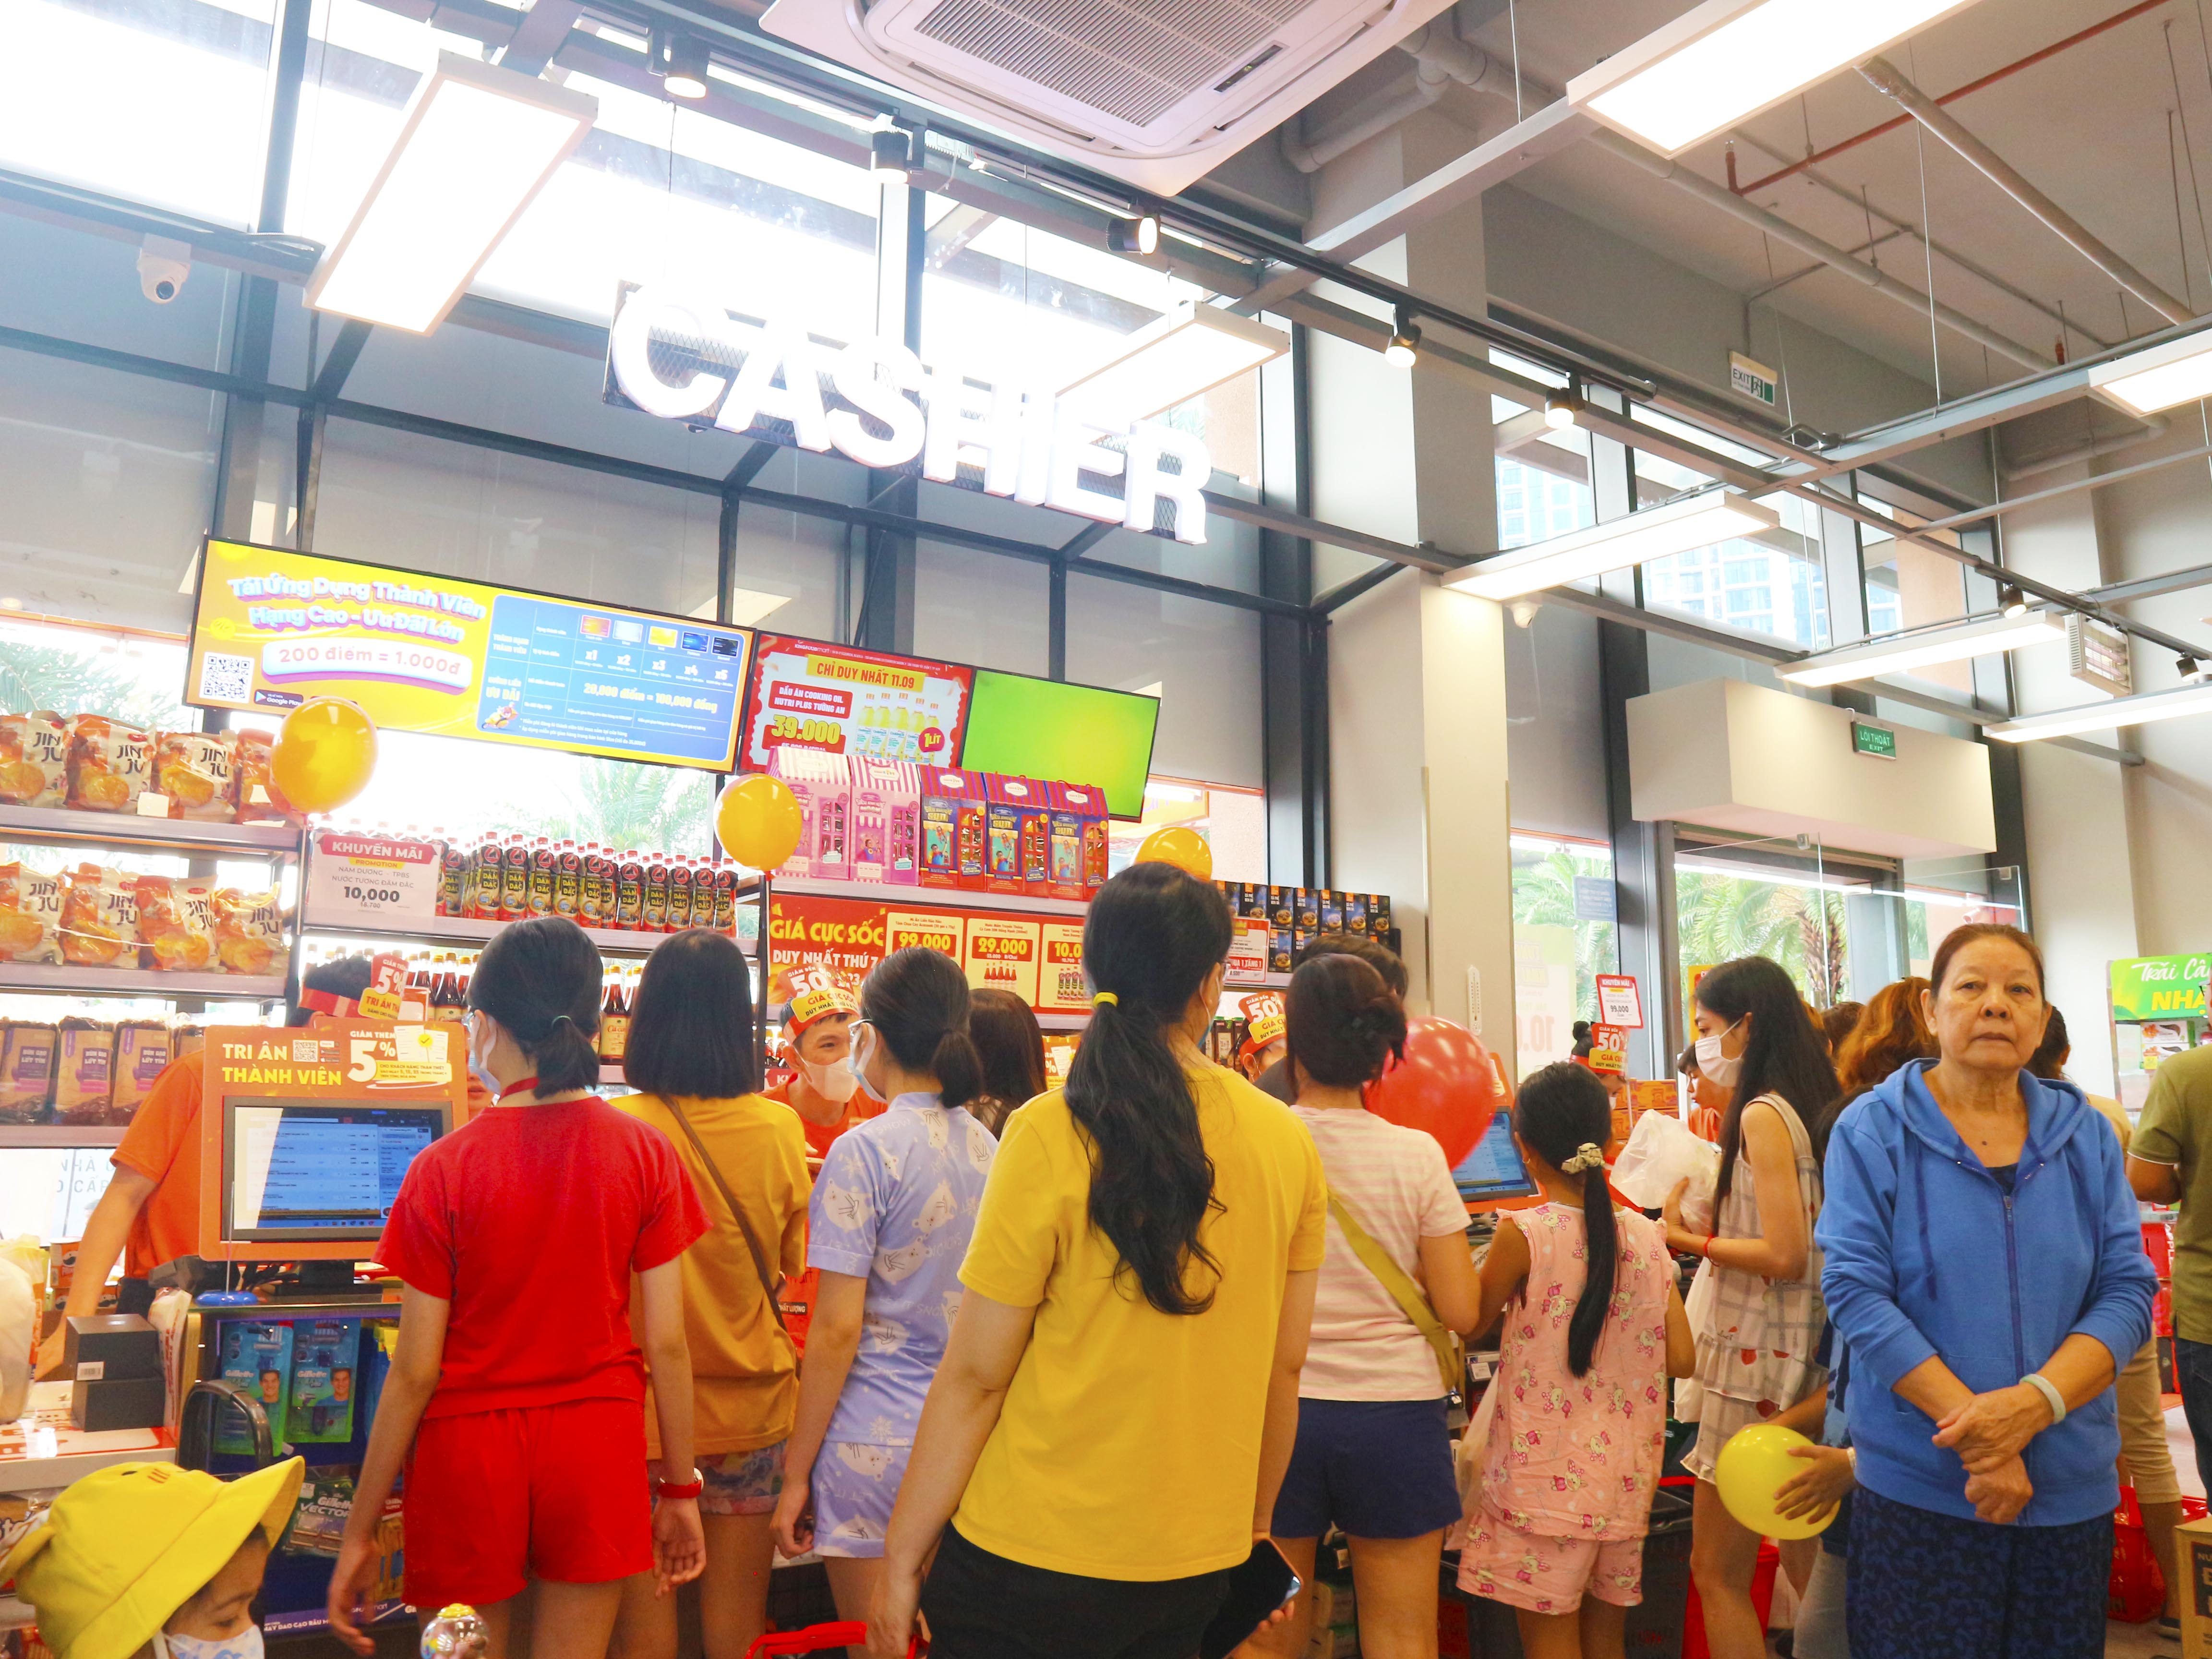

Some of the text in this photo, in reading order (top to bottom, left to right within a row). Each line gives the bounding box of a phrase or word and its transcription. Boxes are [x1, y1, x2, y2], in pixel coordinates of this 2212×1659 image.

[1733, 368, 1750, 385] EXIT
[612, 283, 1211, 544] CASHIER
[313, 577, 370, 601] Dụng
[372, 581, 438, 608] Thành
[439, 593, 486, 619] Viên
[248, 607, 306, 627] Hạng
[307, 605, 349, 624] Cao
[279, 646, 461, 674] 200 điểm 1.000đ
[585, 650, 598, 661] x1
[616, 654, 631, 666] x2
[652, 660, 666, 671] x3
[684, 665, 698, 676] x4
[715, 670, 729, 681] x5
[817, 661, 835, 677] CHỈ
[837, 666, 859, 680] DUY
[861, 669, 889, 685] NHẤT
[891, 674, 915, 689] 11.09
[267, 697, 288, 705] Google
[583, 683, 619, 697] 20,000
[655, 693, 692, 708] 100,000
[779, 685, 793, 696] DẦU
[804, 691, 832, 703] COOKING
[833, 696, 843, 704] OIL
[774, 697, 845, 714] NUTRI PLUS TƯỜNG AN
[771, 714, 842, 745] 39.000
[33, 732, 60, 748] JIN
[1871, 733, 1890, 746] THOÁT
[41, 746, 62, 762] JU
[116, 744, 142, 759] JIN
[200, 748, 226, 763] JIN
[125, 758, 144, 775] JU
[210, 763, 228, 777] JU
[332, 841, 422, 860] KHUYẾN MÃI
[355, 860, 397, 868] PROMOTION
[29, 882, 57, 897] JIN
[344, 886, 400, 902] 10,000
[38, 896, 59, 912] JU
[107, 894, 135, 910] JIN
[186, 898, 210, 917] JIN
[117, 909, 137, 926] JU
[202, 914, 214, 931] JU
[250, 906, 274, 924] JIN
[262, 921, 279, 936] JU
[769, 916, 884, 947] GIÁ CỰC SỐC
[899, 932, 951, 950] 99.000
[978, 937, 1027, 955] 29.000
[1055, 942, 1082, 958] 10.0
[773, 948, 878, 969] DUY NHẤT THỨ 7
[787, 968, 804, 977] GIẢM
[2131, 958, 2210, 982] Trái Câ
[1602, 978, 1630, 987] KHUYẾN MÃI
[366, 996, 379, 1005] TRI
[380, 997, 392, 1008] ÂN
[807, 994, 826, 1005] GIÁ
[805, 1001, 834, 1017] DUY NHẤT
[1610, 1005, 1629, 1014] 99,000
[1262, 1020, 1276, 1029] GIÁ
[350, 1030, 373, 1038] GIẢM
[222, 1040, 288, 1060] TRI ÂN
[222, 1064, 342, 1086] THÀNH VIÊN
[225, 1369, 254, 1379] Gillette
[298, 1370, 327, 1379] Gillette
[317, 1496, 354, 1509] Gillett
